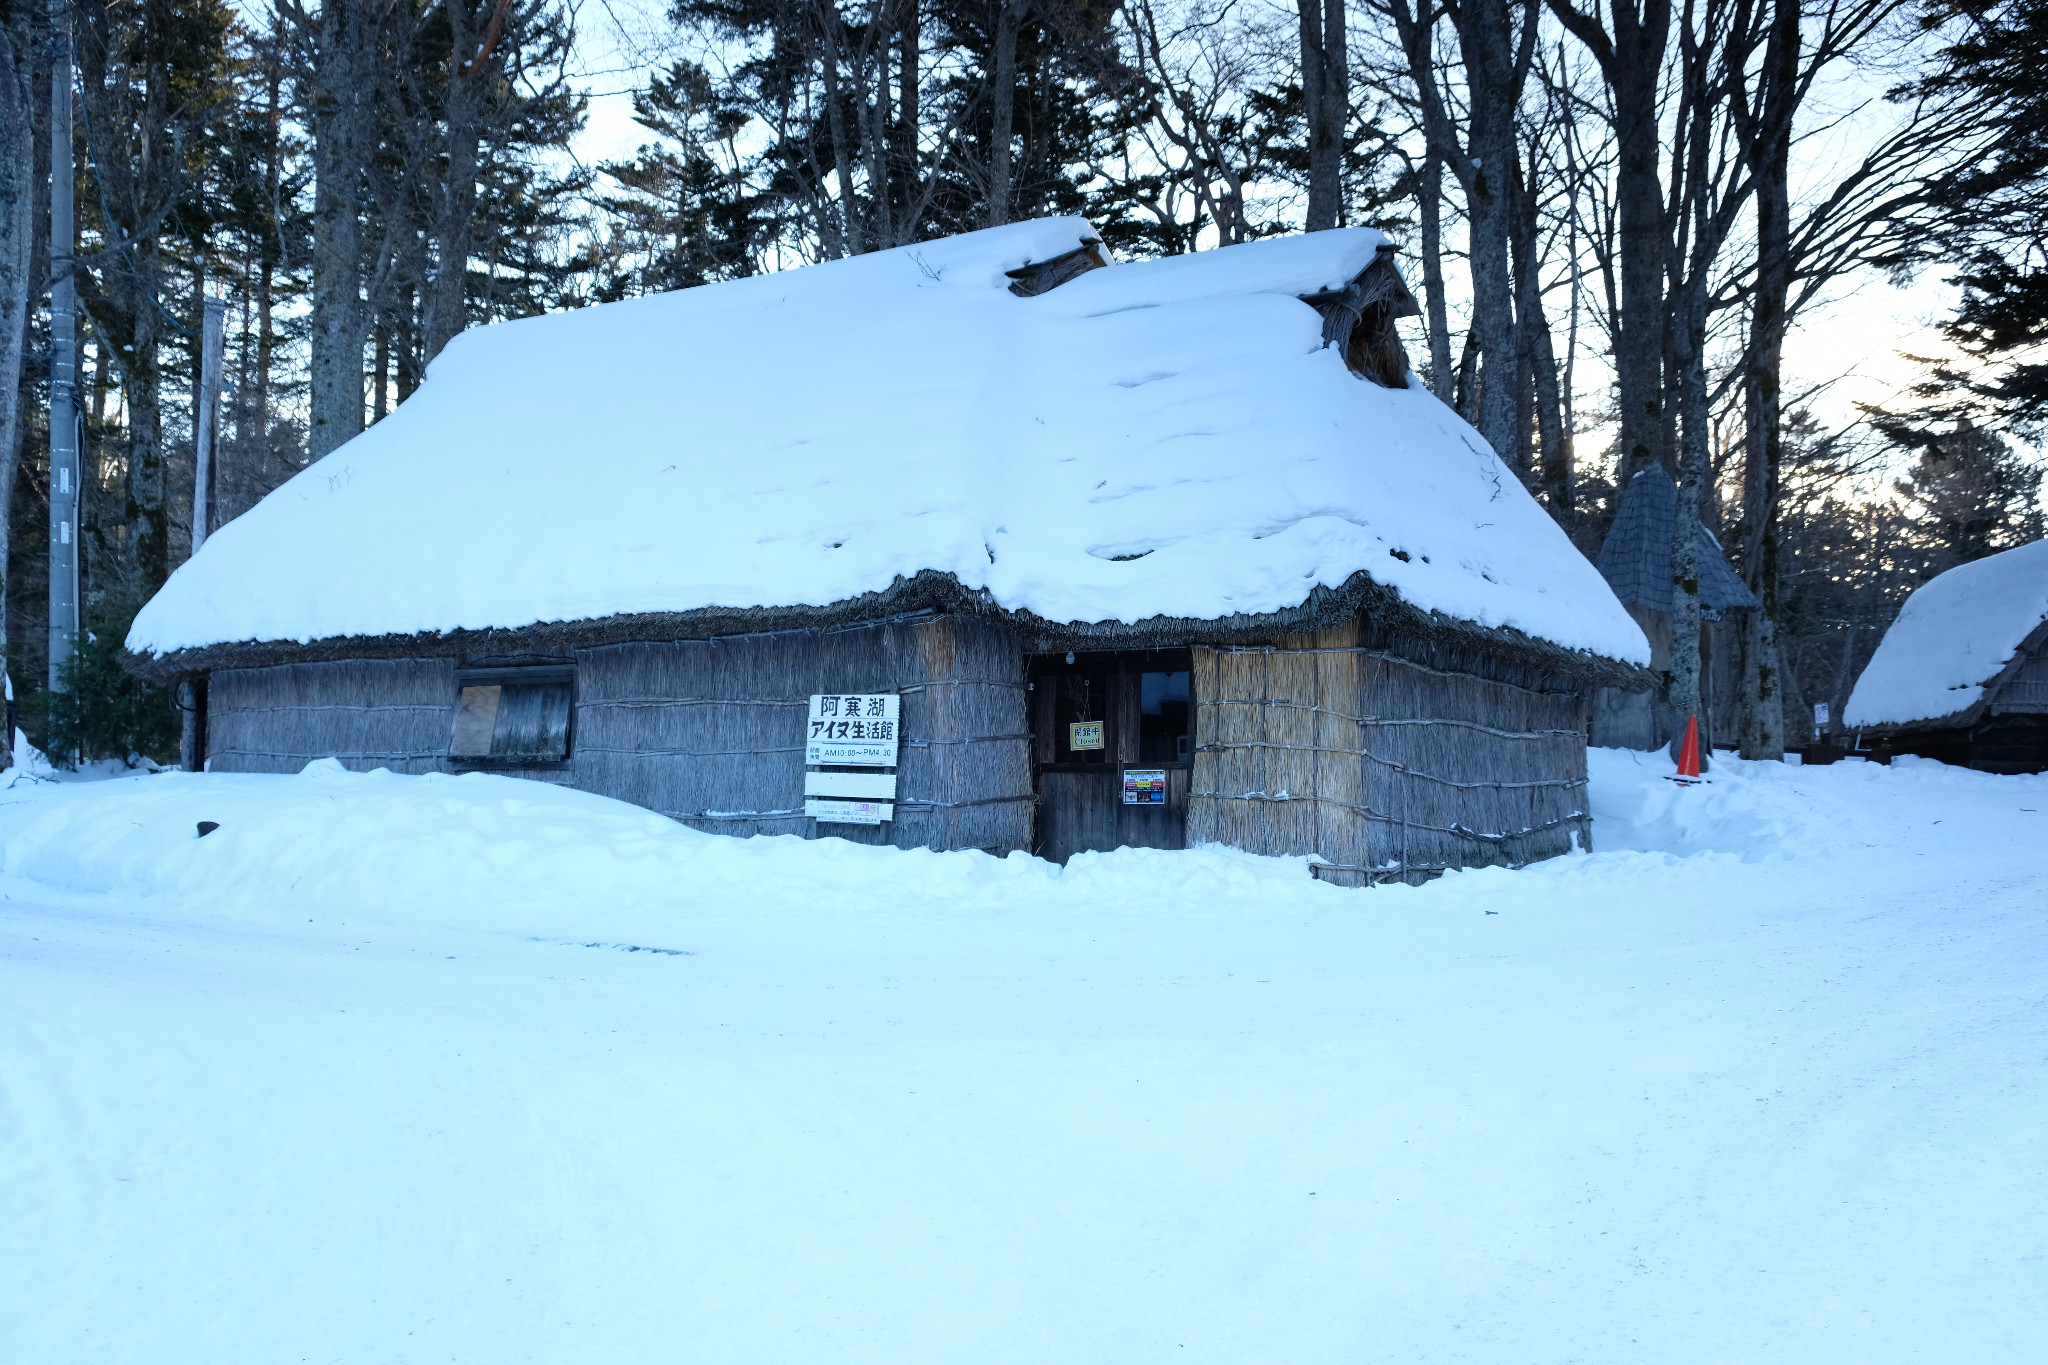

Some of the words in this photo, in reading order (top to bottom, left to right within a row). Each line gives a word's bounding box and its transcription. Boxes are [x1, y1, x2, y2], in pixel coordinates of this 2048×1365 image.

[820, 696, 885, 717] 阿寒湖
[810, 720, 894, 740] アイヌ生活館
